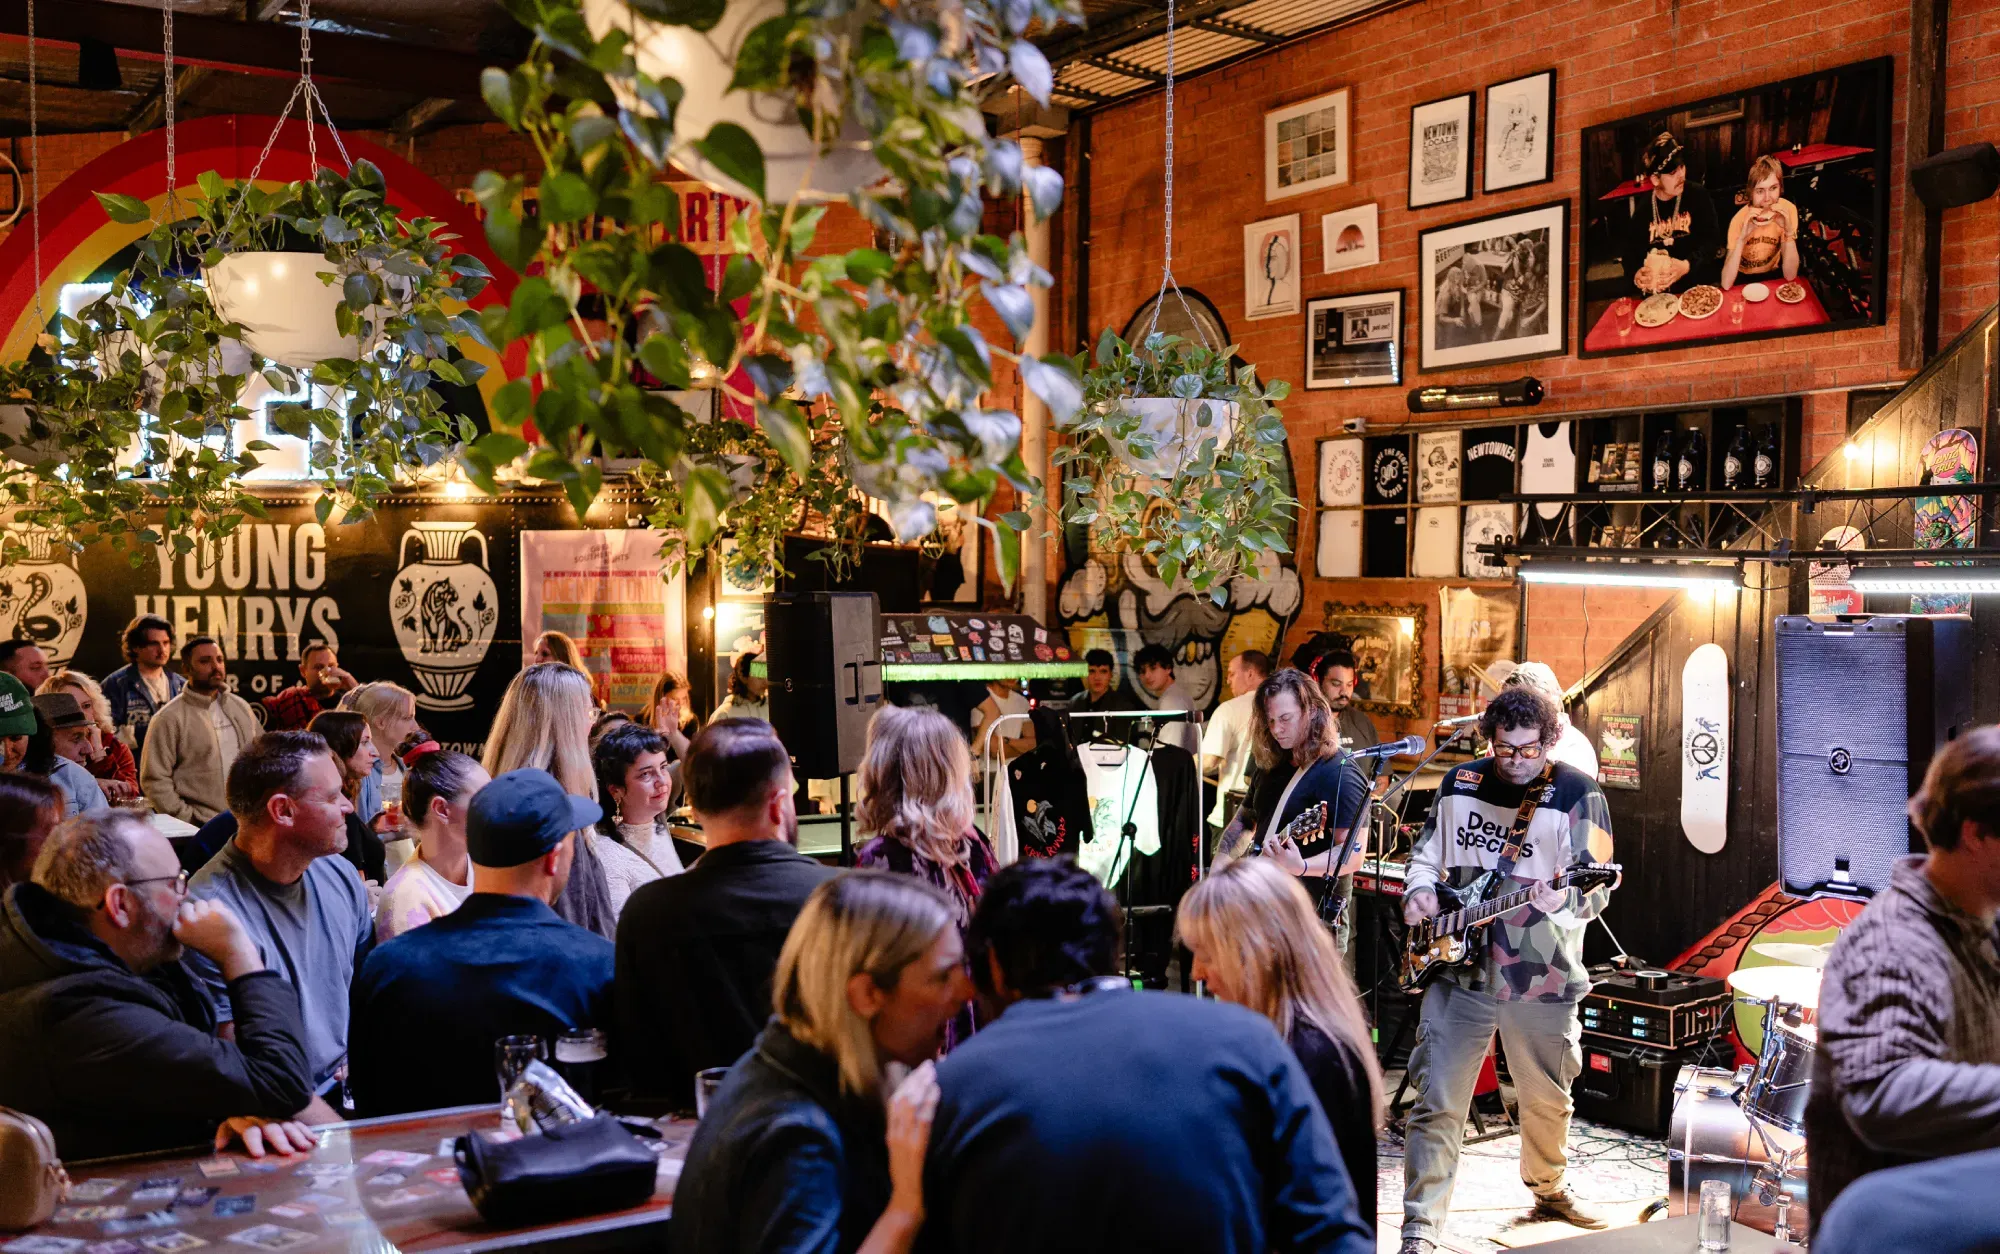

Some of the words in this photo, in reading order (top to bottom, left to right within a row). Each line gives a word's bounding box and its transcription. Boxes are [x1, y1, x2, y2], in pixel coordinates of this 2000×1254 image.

[1424, 120, 1459, 140] NEWTOWN
[1424, 136, 1458, 148] LOCALS
[1934, 460, 1957, 475] CRUZ
[148, 522, 326, 591] YOUNG
[251, 674, 283, 693] OF
[1616, 716, 1639, 724] HARVEST
[1467, 811, 1512, 840] Deu
